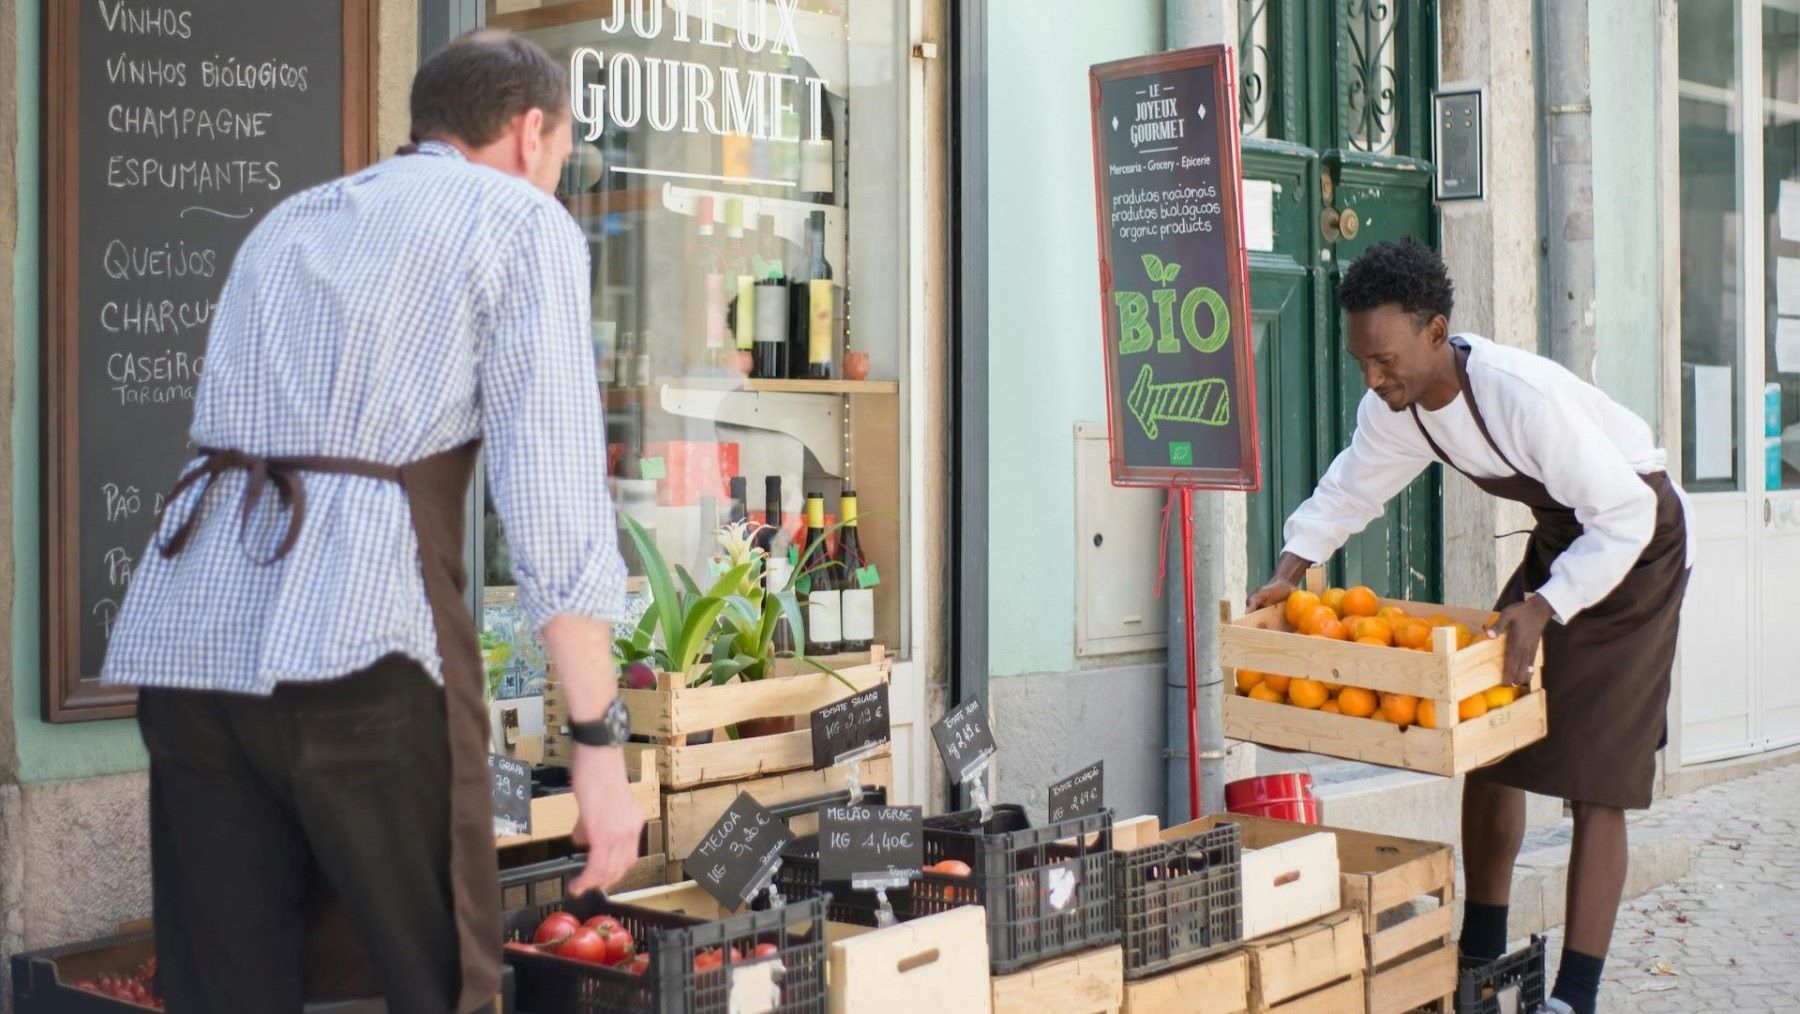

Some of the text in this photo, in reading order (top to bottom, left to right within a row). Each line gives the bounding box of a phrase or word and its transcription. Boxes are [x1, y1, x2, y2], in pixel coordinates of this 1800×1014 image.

[570, 47, 829, 145] GOURMET
[1149, 84, 1160, 98] LE
[109, 105, 272, 140] CHAMPAGNE
[1135, 98, 1178, 122] JOYEUX
[1130, 118, 1185, 148] GOURMET
[108, 155, 281, 193] ESPUMANTES
[1109, 162, 1142, 176] Mercearia
[1147, 160, 1175, 172] Grocery
[1113, 180, 1216, 211] produtos nacionais
[1112, 199, 1221, 229] produtos biológicos
[1120, 216, 1212, 243] organic products
[101, 298, 217, 335] CHARCU
[1115, 286, 1230, 355] BIO
[827, 806, 913, 821] MELÃO VERDE
[699, 810, 741, 856] MELOA
